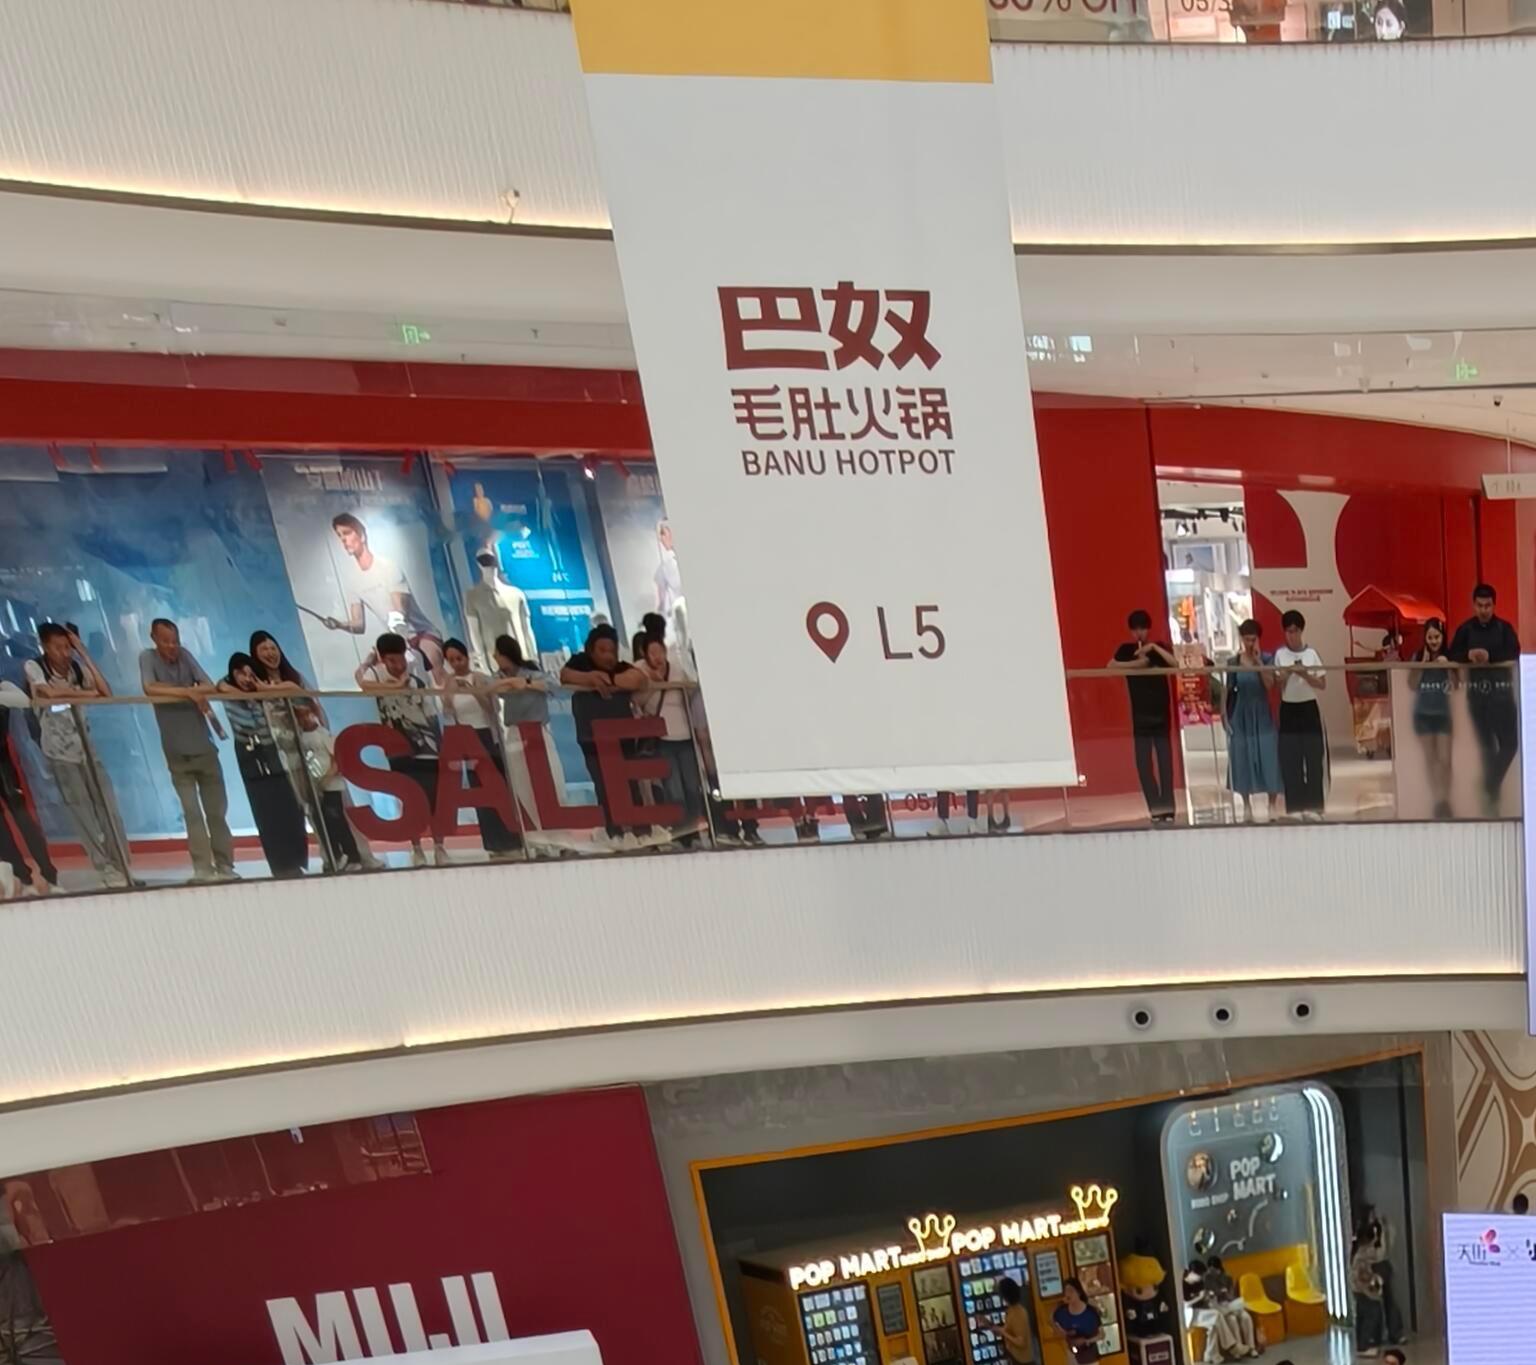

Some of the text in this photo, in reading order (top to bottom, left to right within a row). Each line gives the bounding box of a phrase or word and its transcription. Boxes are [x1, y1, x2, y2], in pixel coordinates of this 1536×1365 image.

[717, 281, 942, 371] 巴奴
[730, 384, 953, 441] 毛肚火锅
[741, 449, 956, 476] BANU HOTPOT
[878, 604, 945, 661] L5
[334, 717, 683, 842] SALE
[1230, 1156, 1261, 1180] POP
[1233, 1173, 1277, 1201] MART
[951, 1226, 997, 1256] POP
[1000, 1214, 1062, 1246] MART
[788, 1259, 836, 1290] POP
[839, 1245, 902, 1280] MART
